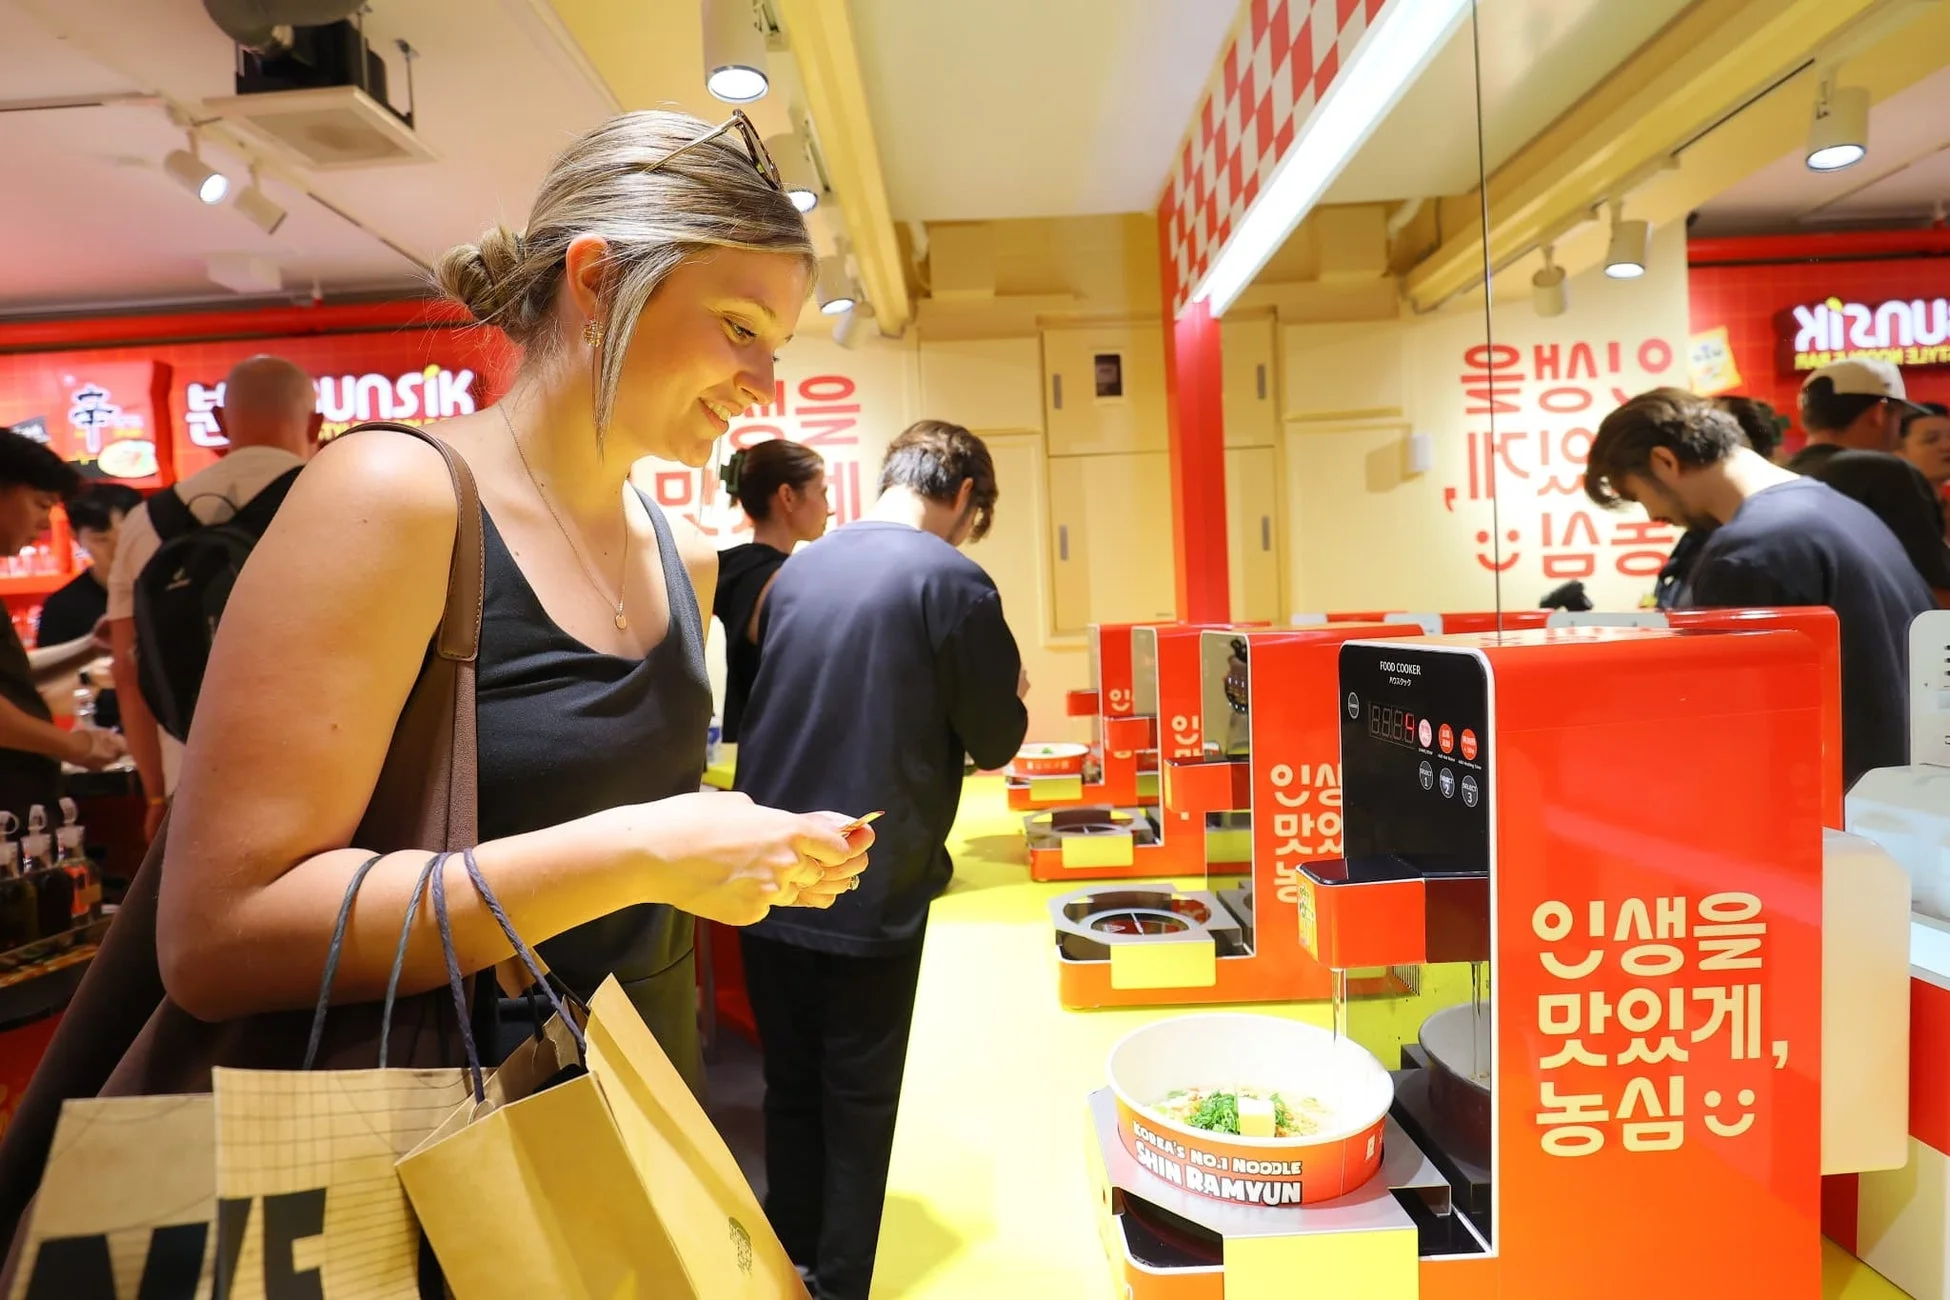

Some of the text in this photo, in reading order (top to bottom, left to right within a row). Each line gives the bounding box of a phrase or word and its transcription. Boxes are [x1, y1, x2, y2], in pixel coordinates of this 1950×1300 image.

[314, 364, 476, 421] UNSIK
[1379, 660, 1421, 675] FOOD COOKER
[1462, 782, 1477, 792] SELECT
[1467, 792, 1473, 803] 3
[1531, 892, 1767, 979] 인생을
[1538, 984, 1788, 1069] 맛있게,
[1536, 1075, 1685, 1157] 농심
[1133, 1120, 1302, 1176] KOREA'S NO.1 NOODLE
[1135, 1139, 1303, 1206] SHIN RAMYUN
